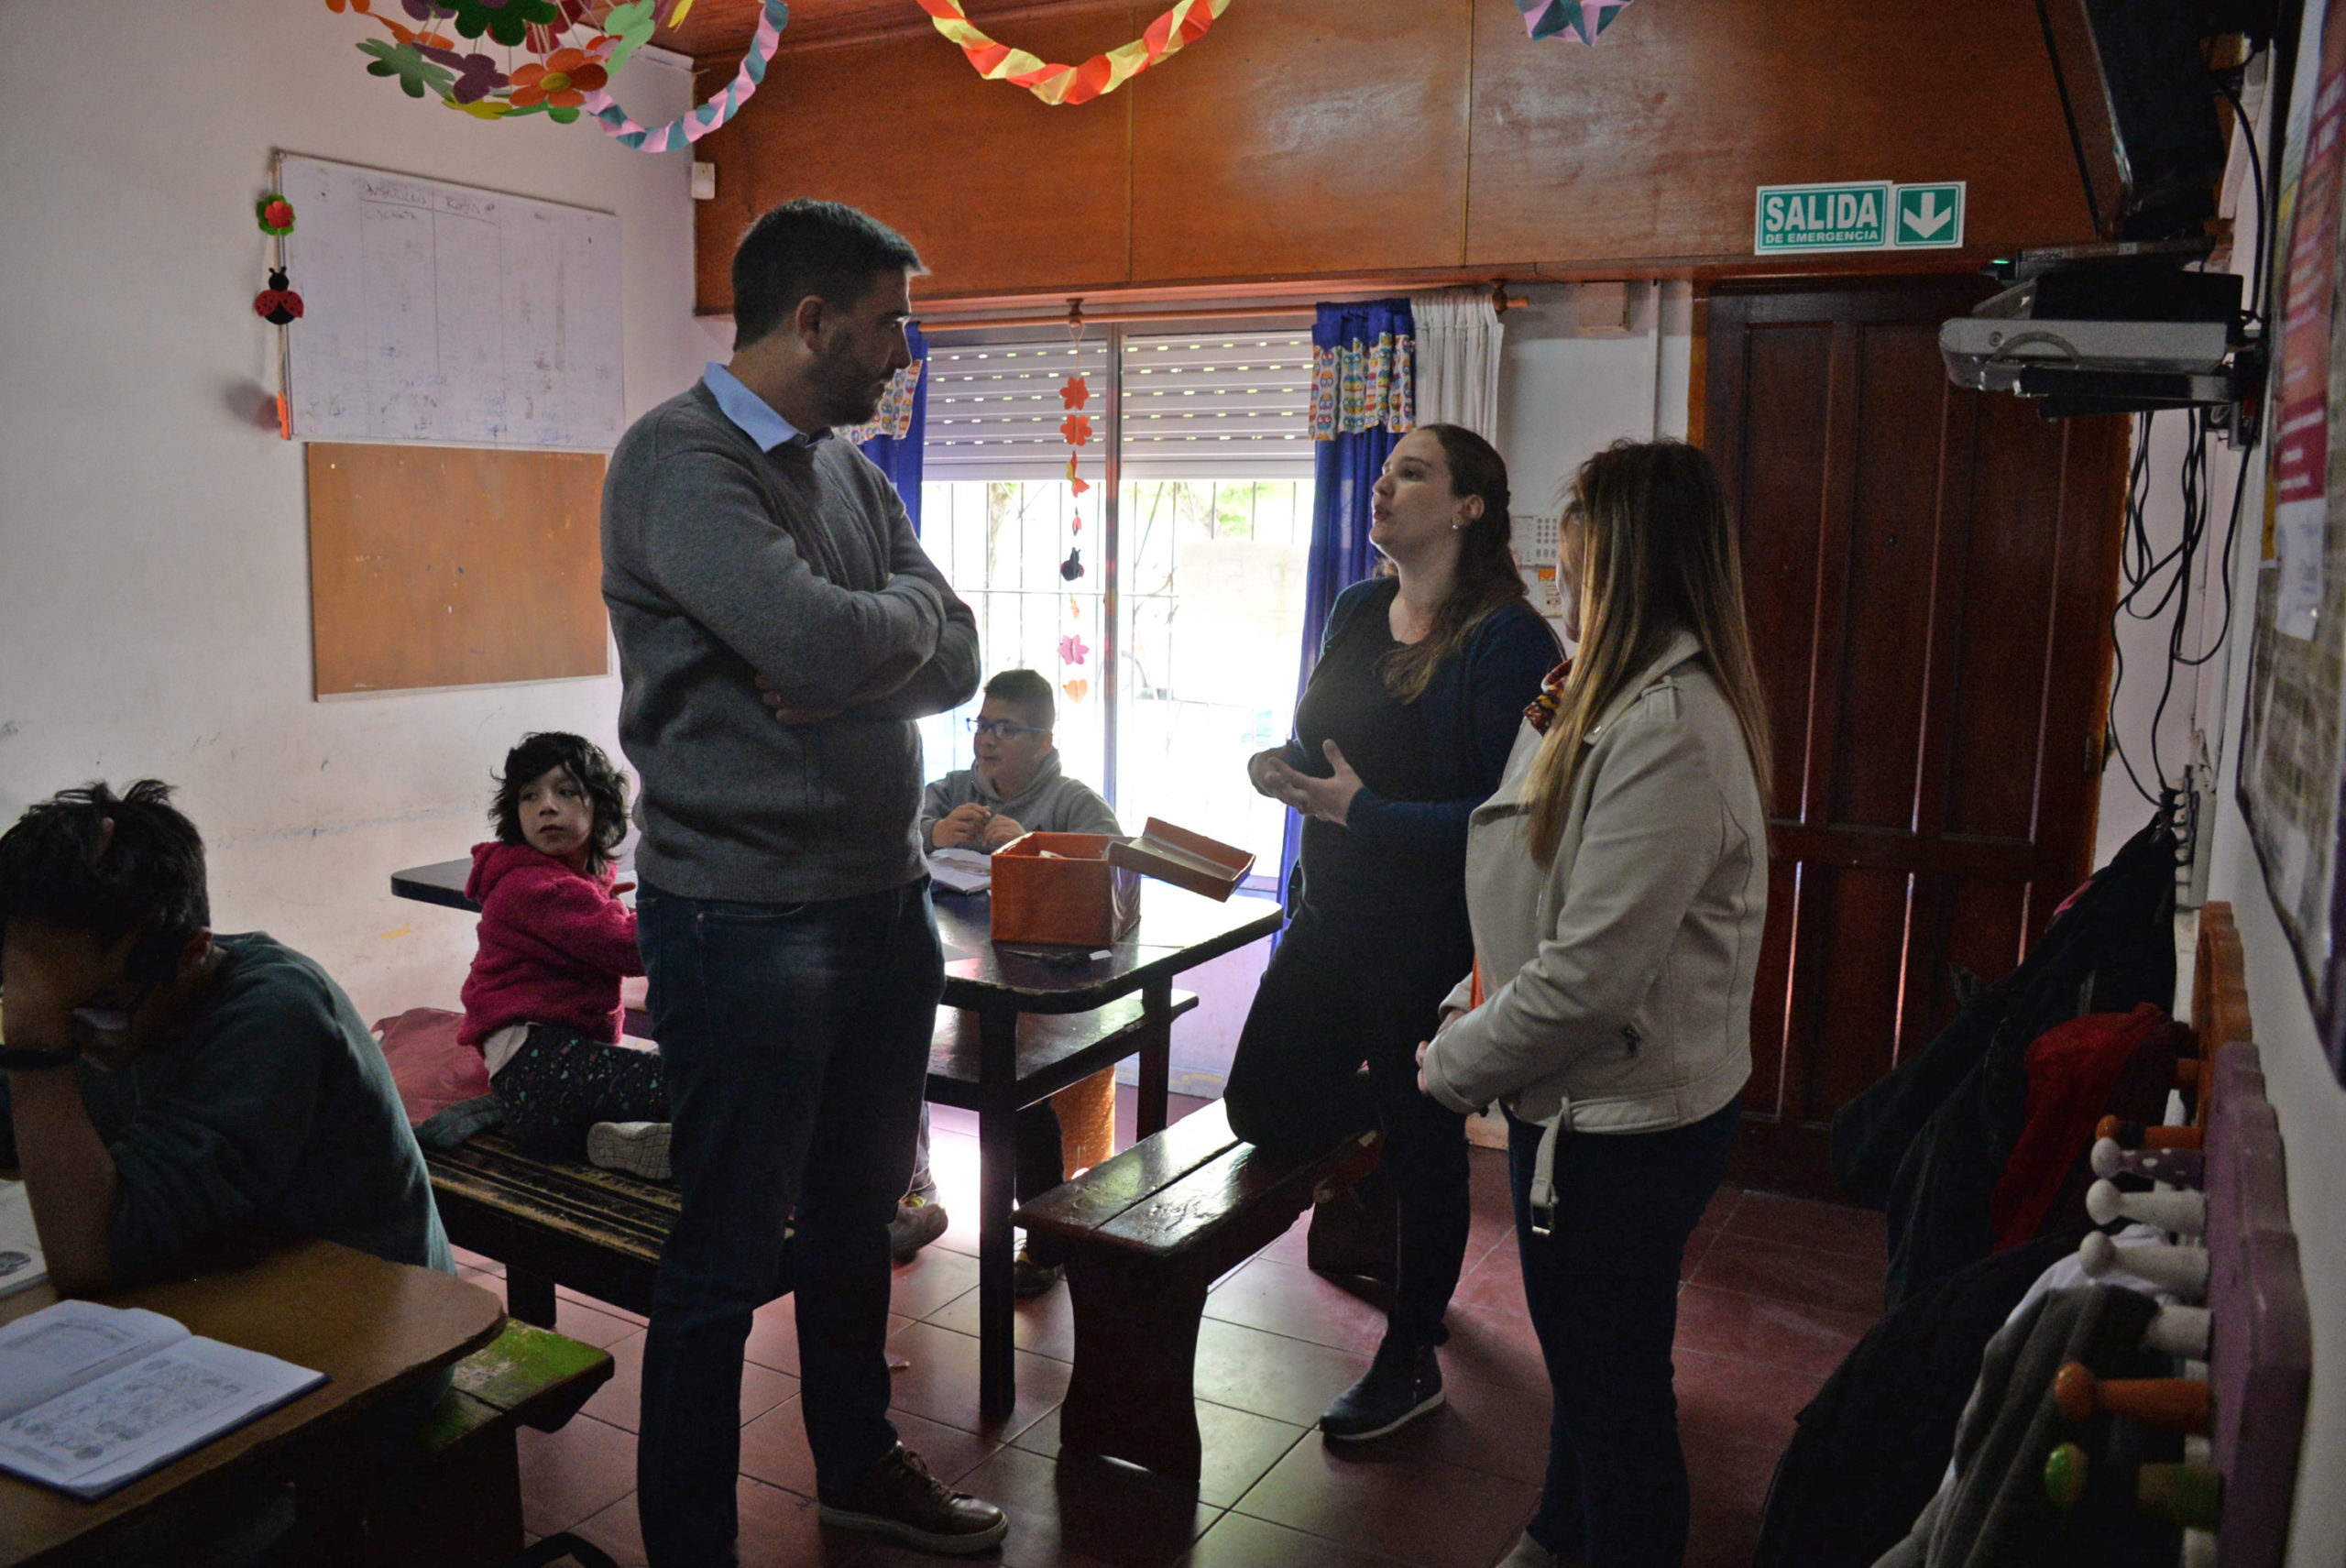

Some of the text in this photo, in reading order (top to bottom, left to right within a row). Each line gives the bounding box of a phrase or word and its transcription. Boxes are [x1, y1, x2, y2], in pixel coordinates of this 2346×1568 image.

[1766, 192, 1878, 232] SALIDA
[1766, 230, 1878, 244] DE EMERGENCIA
